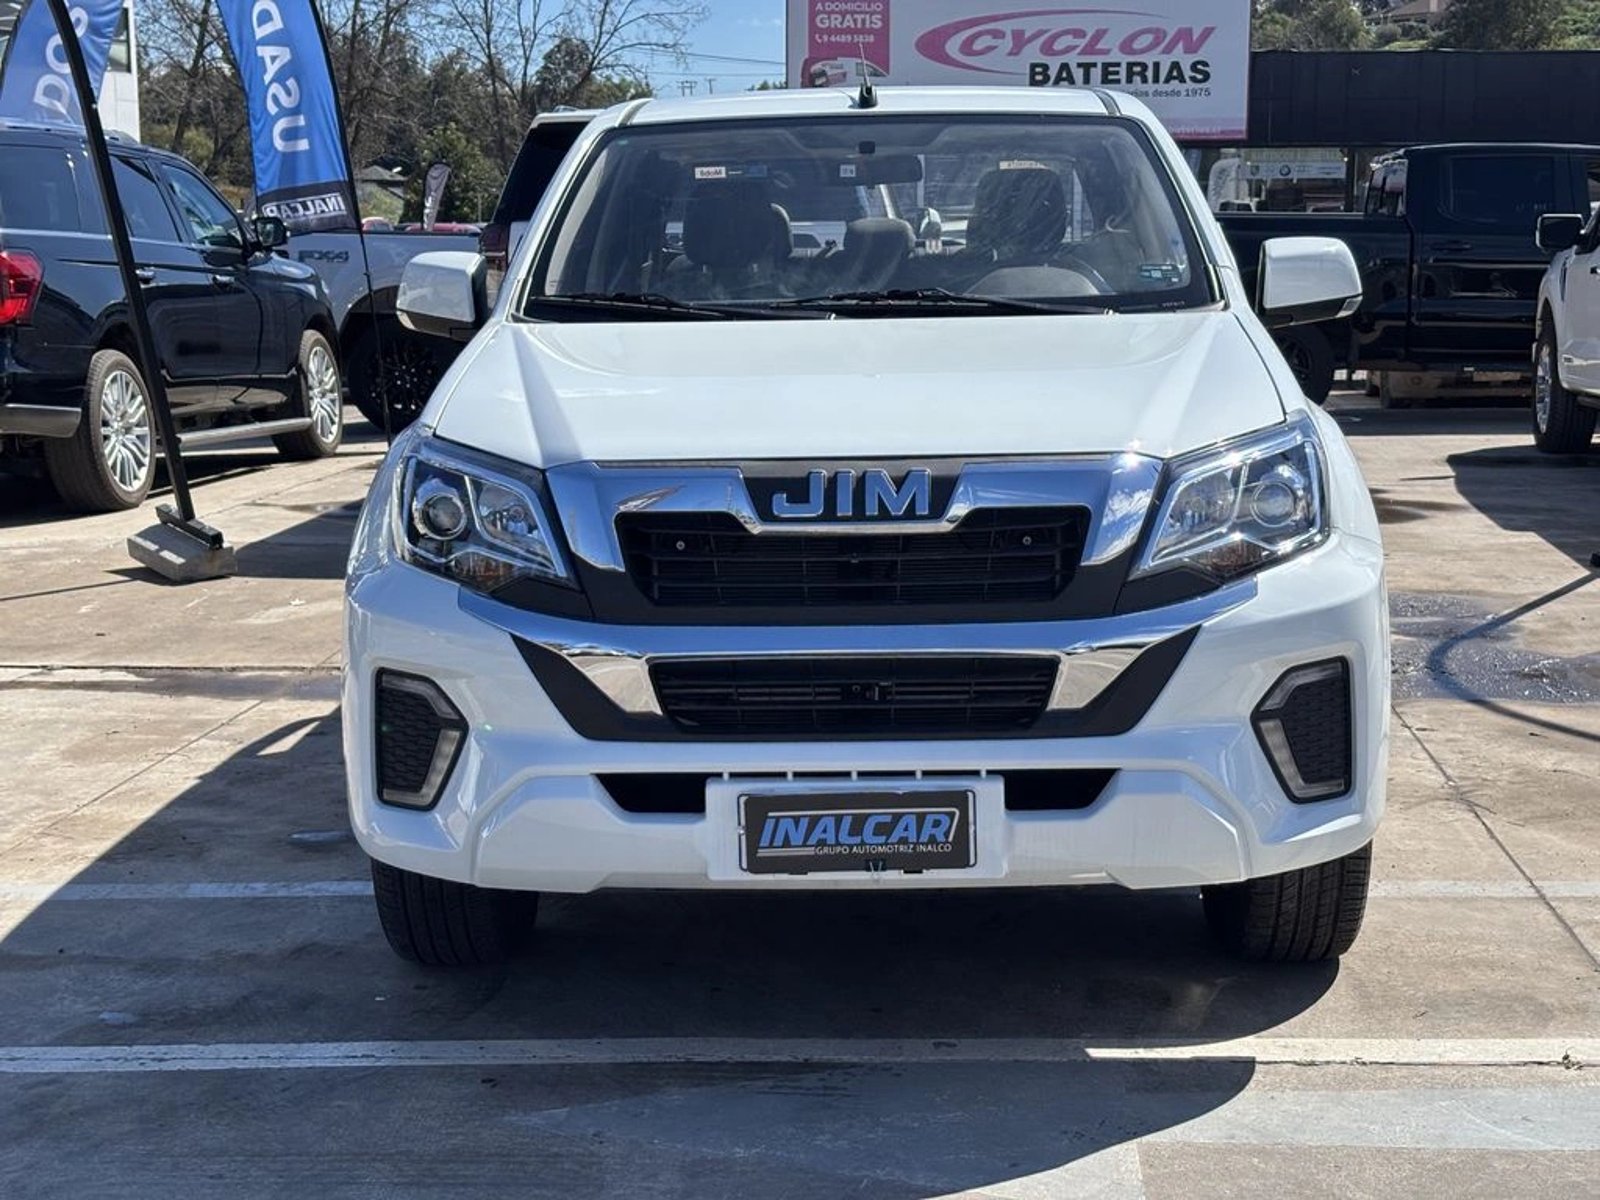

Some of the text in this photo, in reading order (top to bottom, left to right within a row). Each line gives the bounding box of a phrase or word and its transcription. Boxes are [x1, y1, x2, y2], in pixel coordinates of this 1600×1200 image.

[815, 2, 884, 11] A DOMICILIO
[815, 14, 883, 29] GRATIS
[957, 26, 1217, 57] CYCLON
[1028, 60, 1212, 87] BATERIAS
[1152, 88, 1182, 98] desde
[1184, 87, 1212, 98] 1975
[771, 468, 932, 517] JIM
[759, 813, 951, 848] INALCAR
[816, 843, 952, 855] GRUPO AUTOMOTRIZ INALCO
